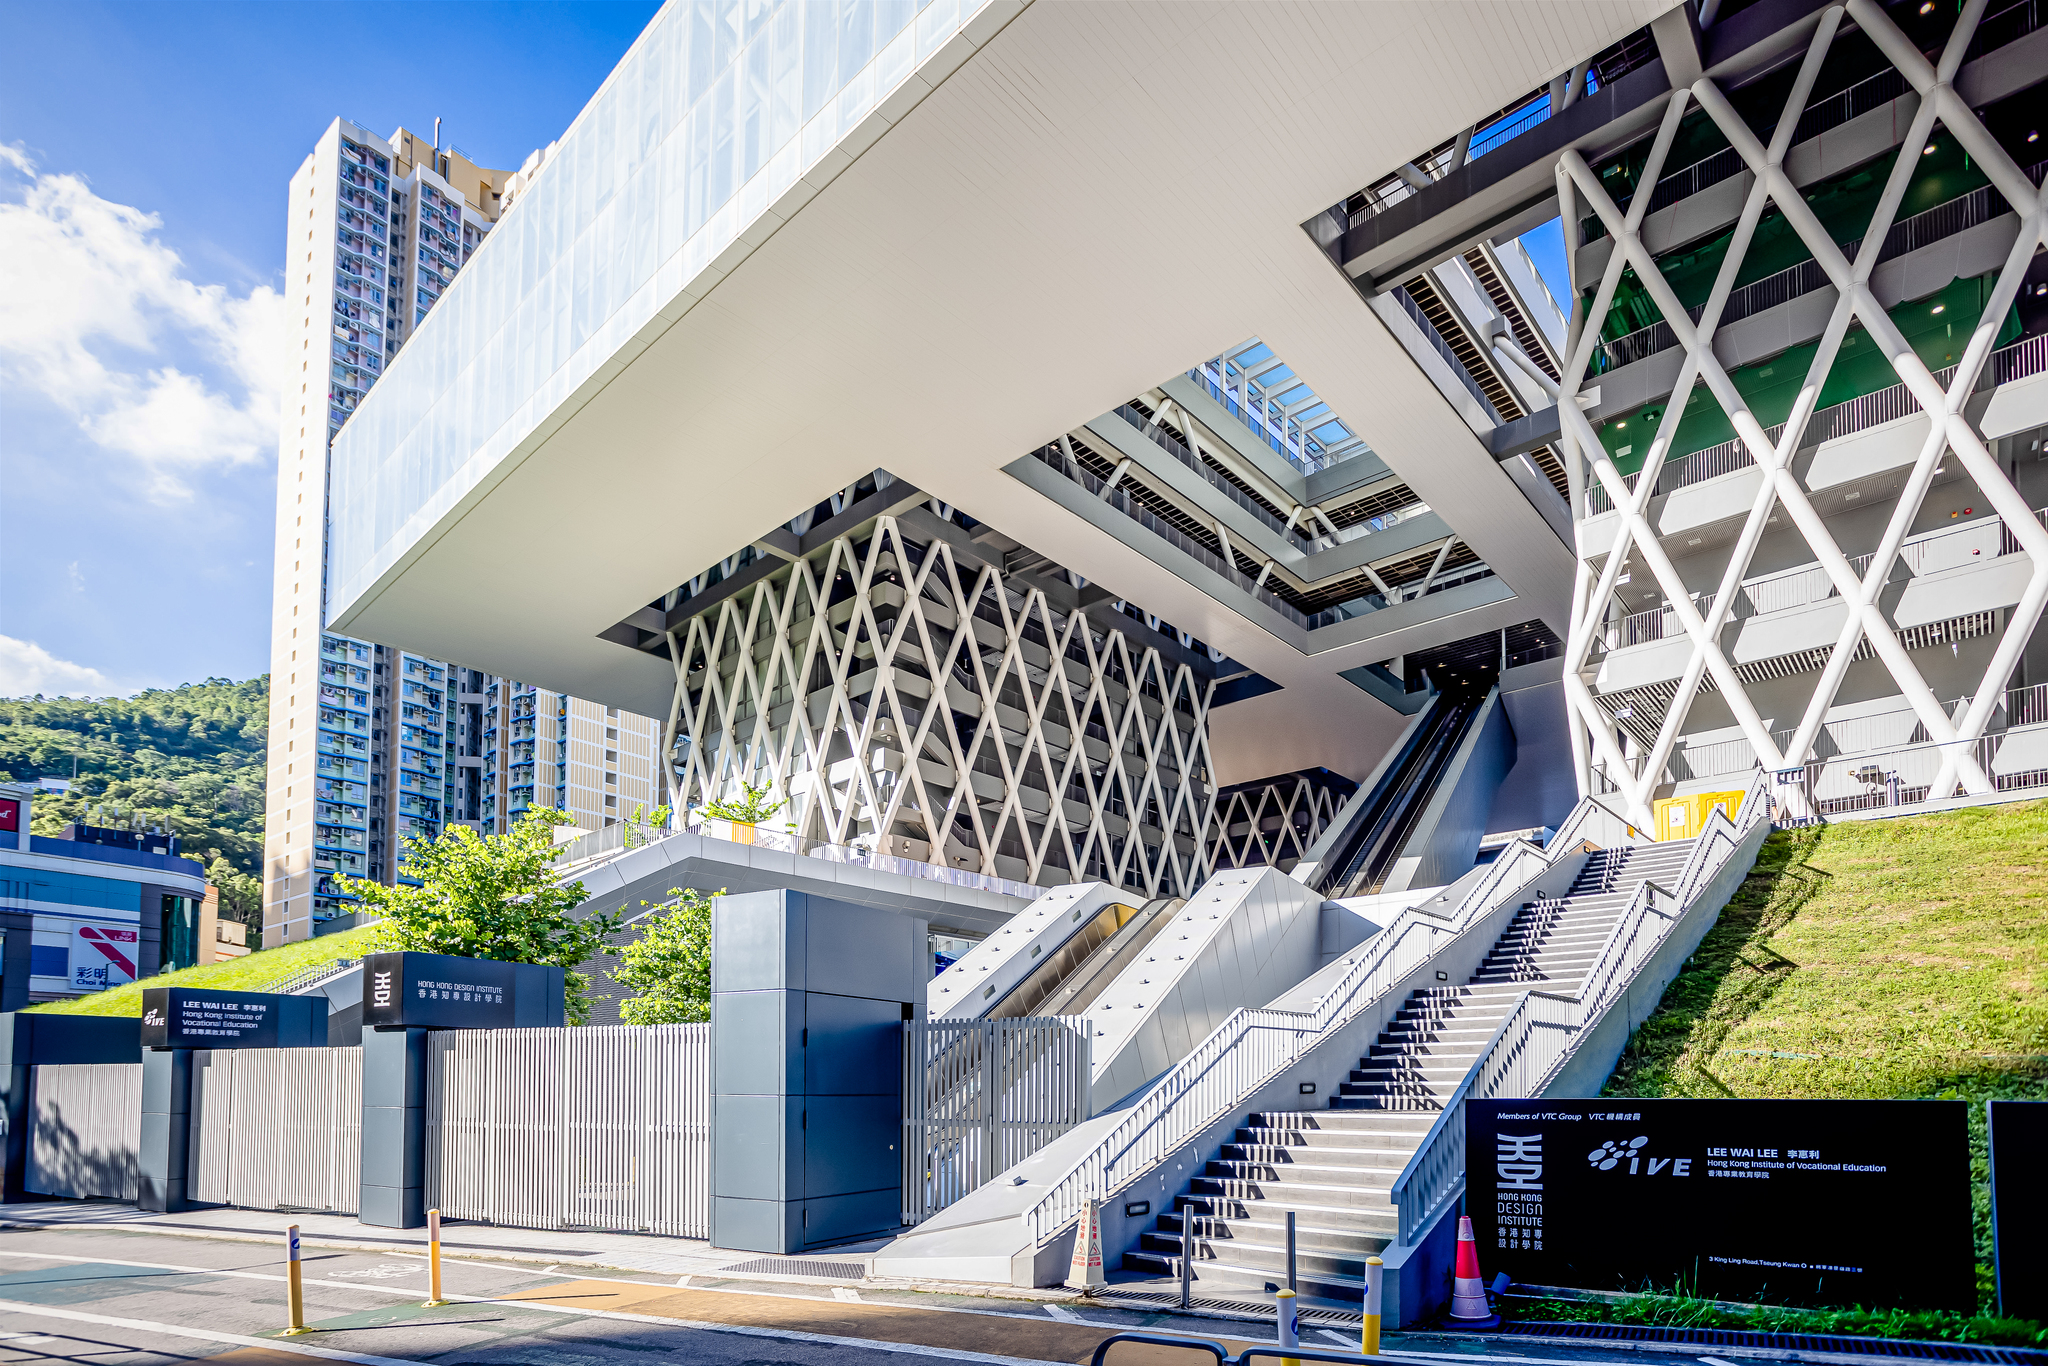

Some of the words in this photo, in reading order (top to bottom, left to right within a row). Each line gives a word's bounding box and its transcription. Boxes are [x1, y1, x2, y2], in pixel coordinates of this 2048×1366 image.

[476, 985, 502, 994] INSTITUTE
[418, 988, 502, 1004] 香港知專設計學院
[1707, 1148, 1727, 1157] LEE
[1730, 1148, 1754, 1157] WAI
[1757, 1149, 1778, 1158] LEE
[1787, 1150, 1820, 1159] 李惠利
[1629, 1157, 1692, 1176] IVE
[1707, 1159, 1728, 1168] Hong
[1730, 1160, 1750, 1168] Kong
[1751, 1160, 1784, 1169] Institute
[1796, 1162, 1840, 1171] Vocational
[1843, 1164, 1886, 1172] Education
[1497, 1193, 1518, 1201] HONG
[1497, 1202, 1542, 1215] DESIGN
[1498, 1215, 1542, 1226] INSTITUTE
[1498, 1227, 1542, 1239] 香港知專
[1498, 1238, 1543, 1250] 設計學院
